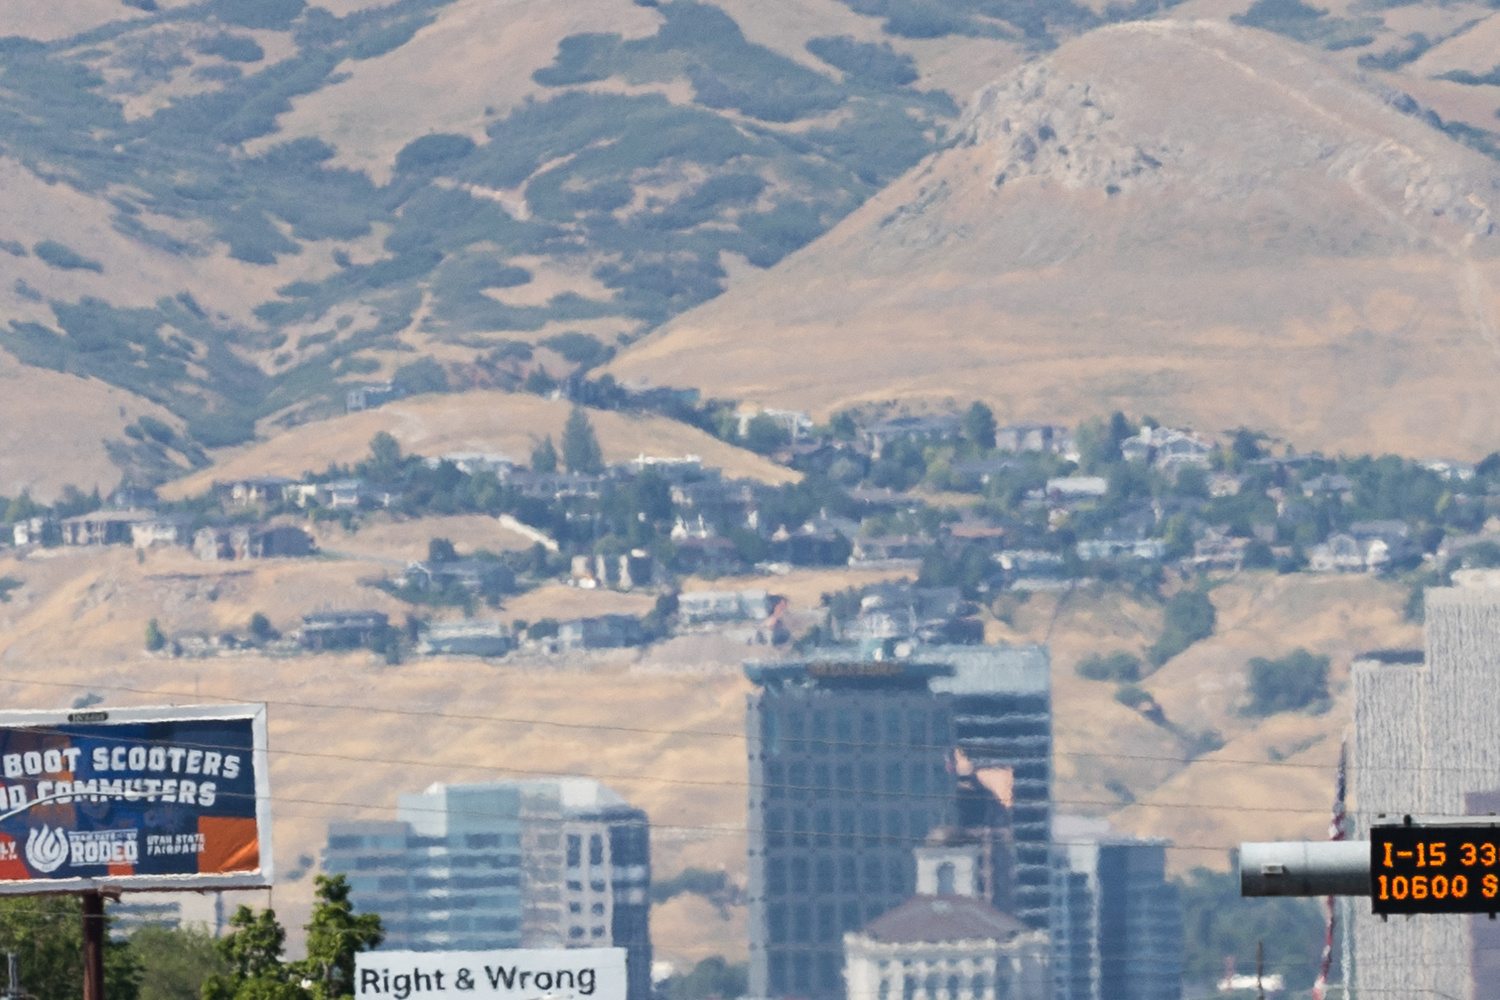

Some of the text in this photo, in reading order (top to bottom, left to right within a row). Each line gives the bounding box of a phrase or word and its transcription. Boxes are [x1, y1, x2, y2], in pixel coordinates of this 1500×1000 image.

[3, 747, 241, 780] BOOT SCOOTERS
[37, 778, 218, 807] COMMUTERS
[70, 840, 139, 864] RODEO
[146, 834, 173, 846] UTAH
[174, 832, 205, 845] STATE
[1383, 842, 1448, 868] I-15
[1378, 874, 1469, 901] 10600
[1482, 873, 1499, 898] S
[361, 964, 596, 1000] Right & Wrong
